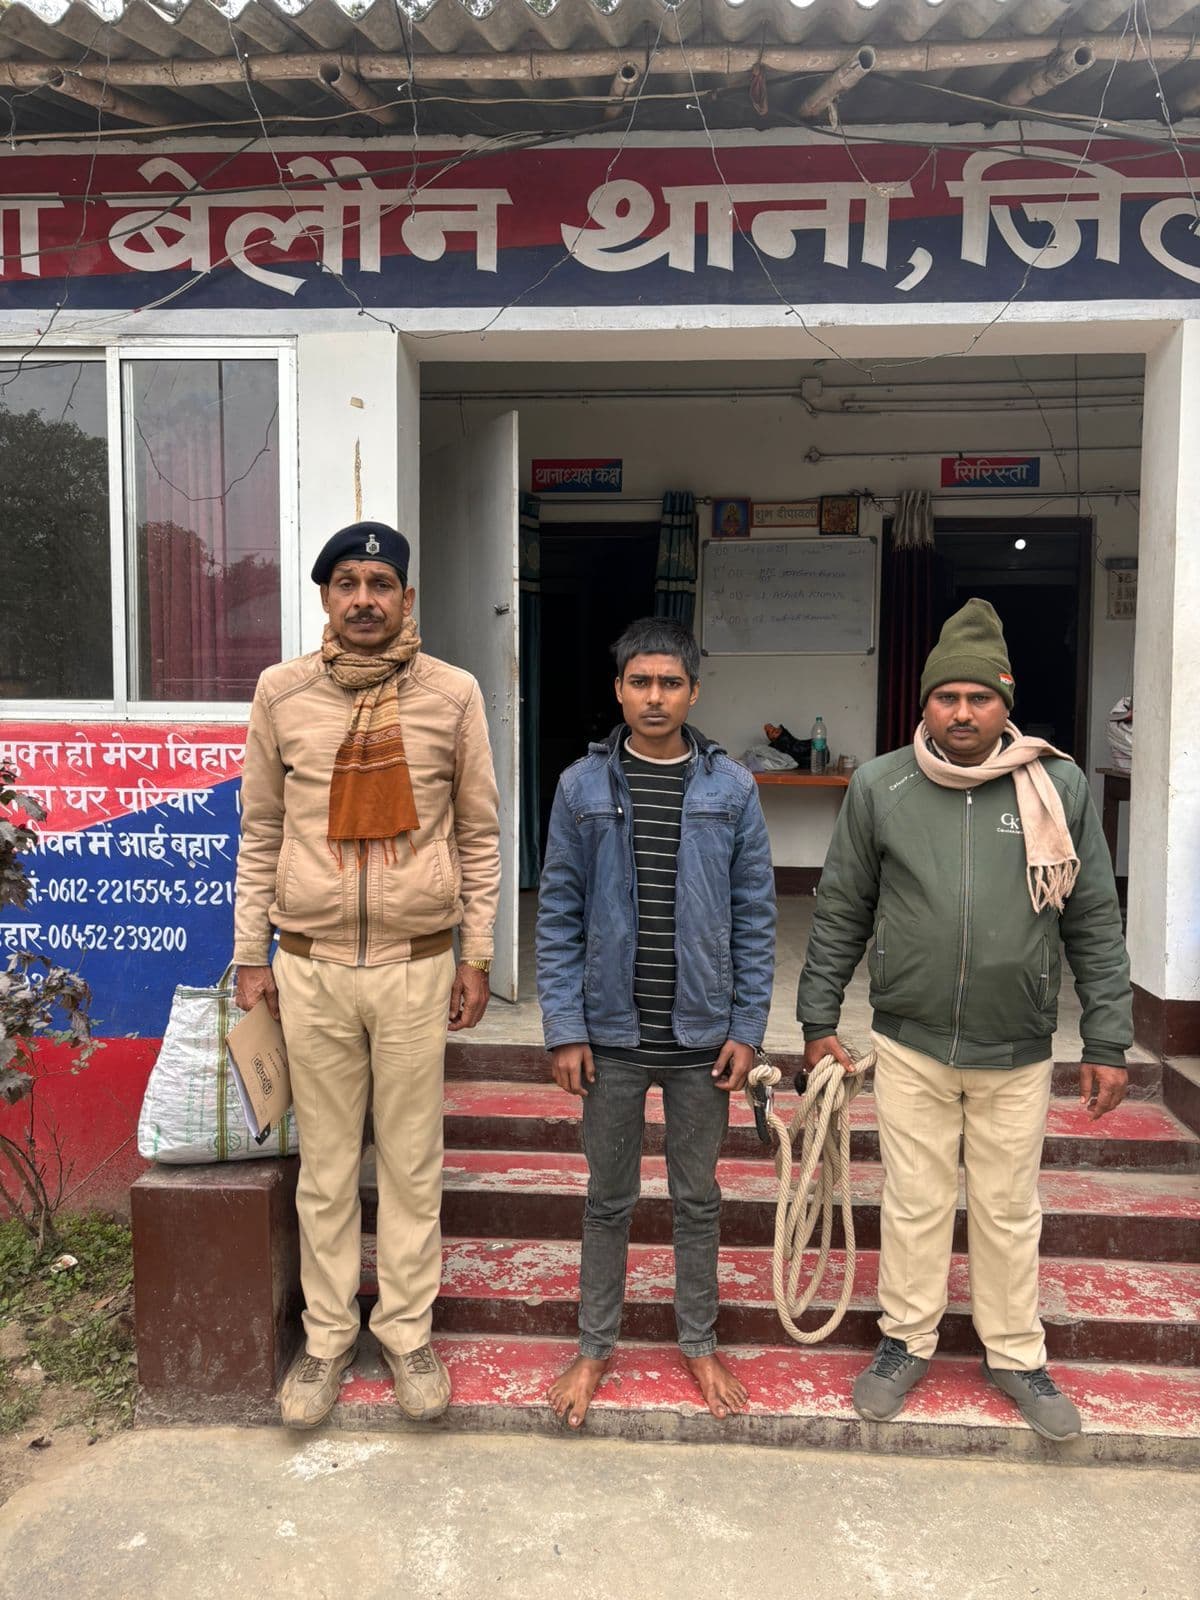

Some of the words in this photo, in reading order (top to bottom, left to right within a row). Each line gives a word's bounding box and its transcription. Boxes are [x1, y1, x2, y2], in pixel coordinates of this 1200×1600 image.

[102, 156, 513, 295] बेलौन
[561, 178, 933, 291] थाना,
[536, 468, 593, 487] थानाध्यक्ष
[595, 468, 621, 487] कक्ष
[953, 459, 1030, 483] सिरिस्ता
[65, 732, 96, 776] हो
[100, 732, 163, 771] मेरा
[165, 733, 246, 778] बिहार
[60, 786, 111, 816] घर
[115, 778, 215, 817] परिवार
[86, 822, 113, 859] में
[114, 824, 174, 867] आई
[170, 834, 231, 868] बहार
[0, 923, 187, 952] हार-06452-239200
